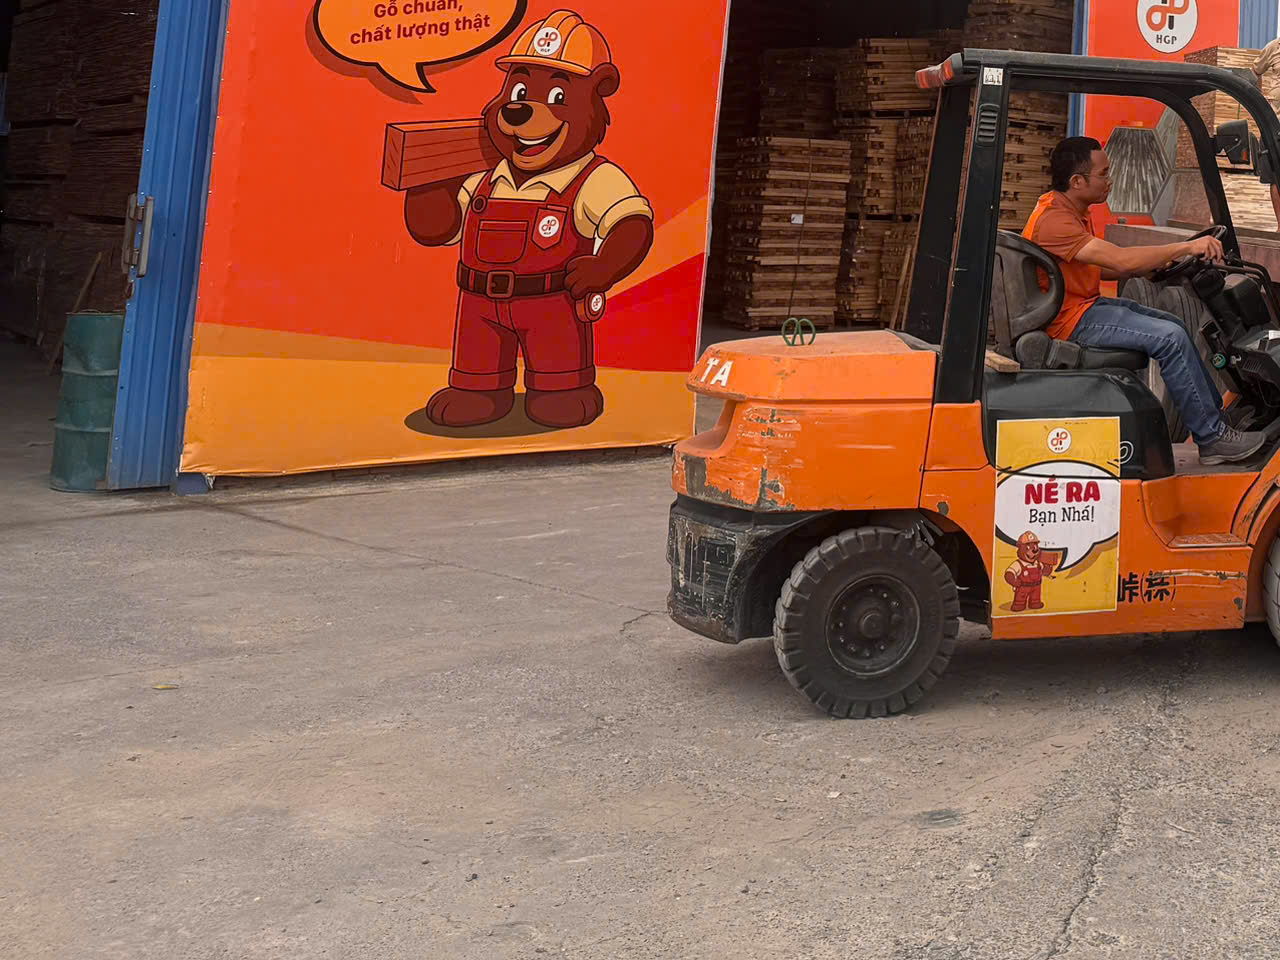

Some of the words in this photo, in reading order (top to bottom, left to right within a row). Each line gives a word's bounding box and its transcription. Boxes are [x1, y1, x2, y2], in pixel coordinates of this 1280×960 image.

[350, 25, 392, 45] chất
[397, 20, 450, 40] lượng
[455, 13, 491, 33] thật
[1156, 34, 1177, 45] HGP
[1025, 474, 1058, 505] NÉ
[1066, 481, 1100, 503] RA
[1029, 508, 1056, 526] Bạn
[1061, 505, 1094, 523] Nhá!
